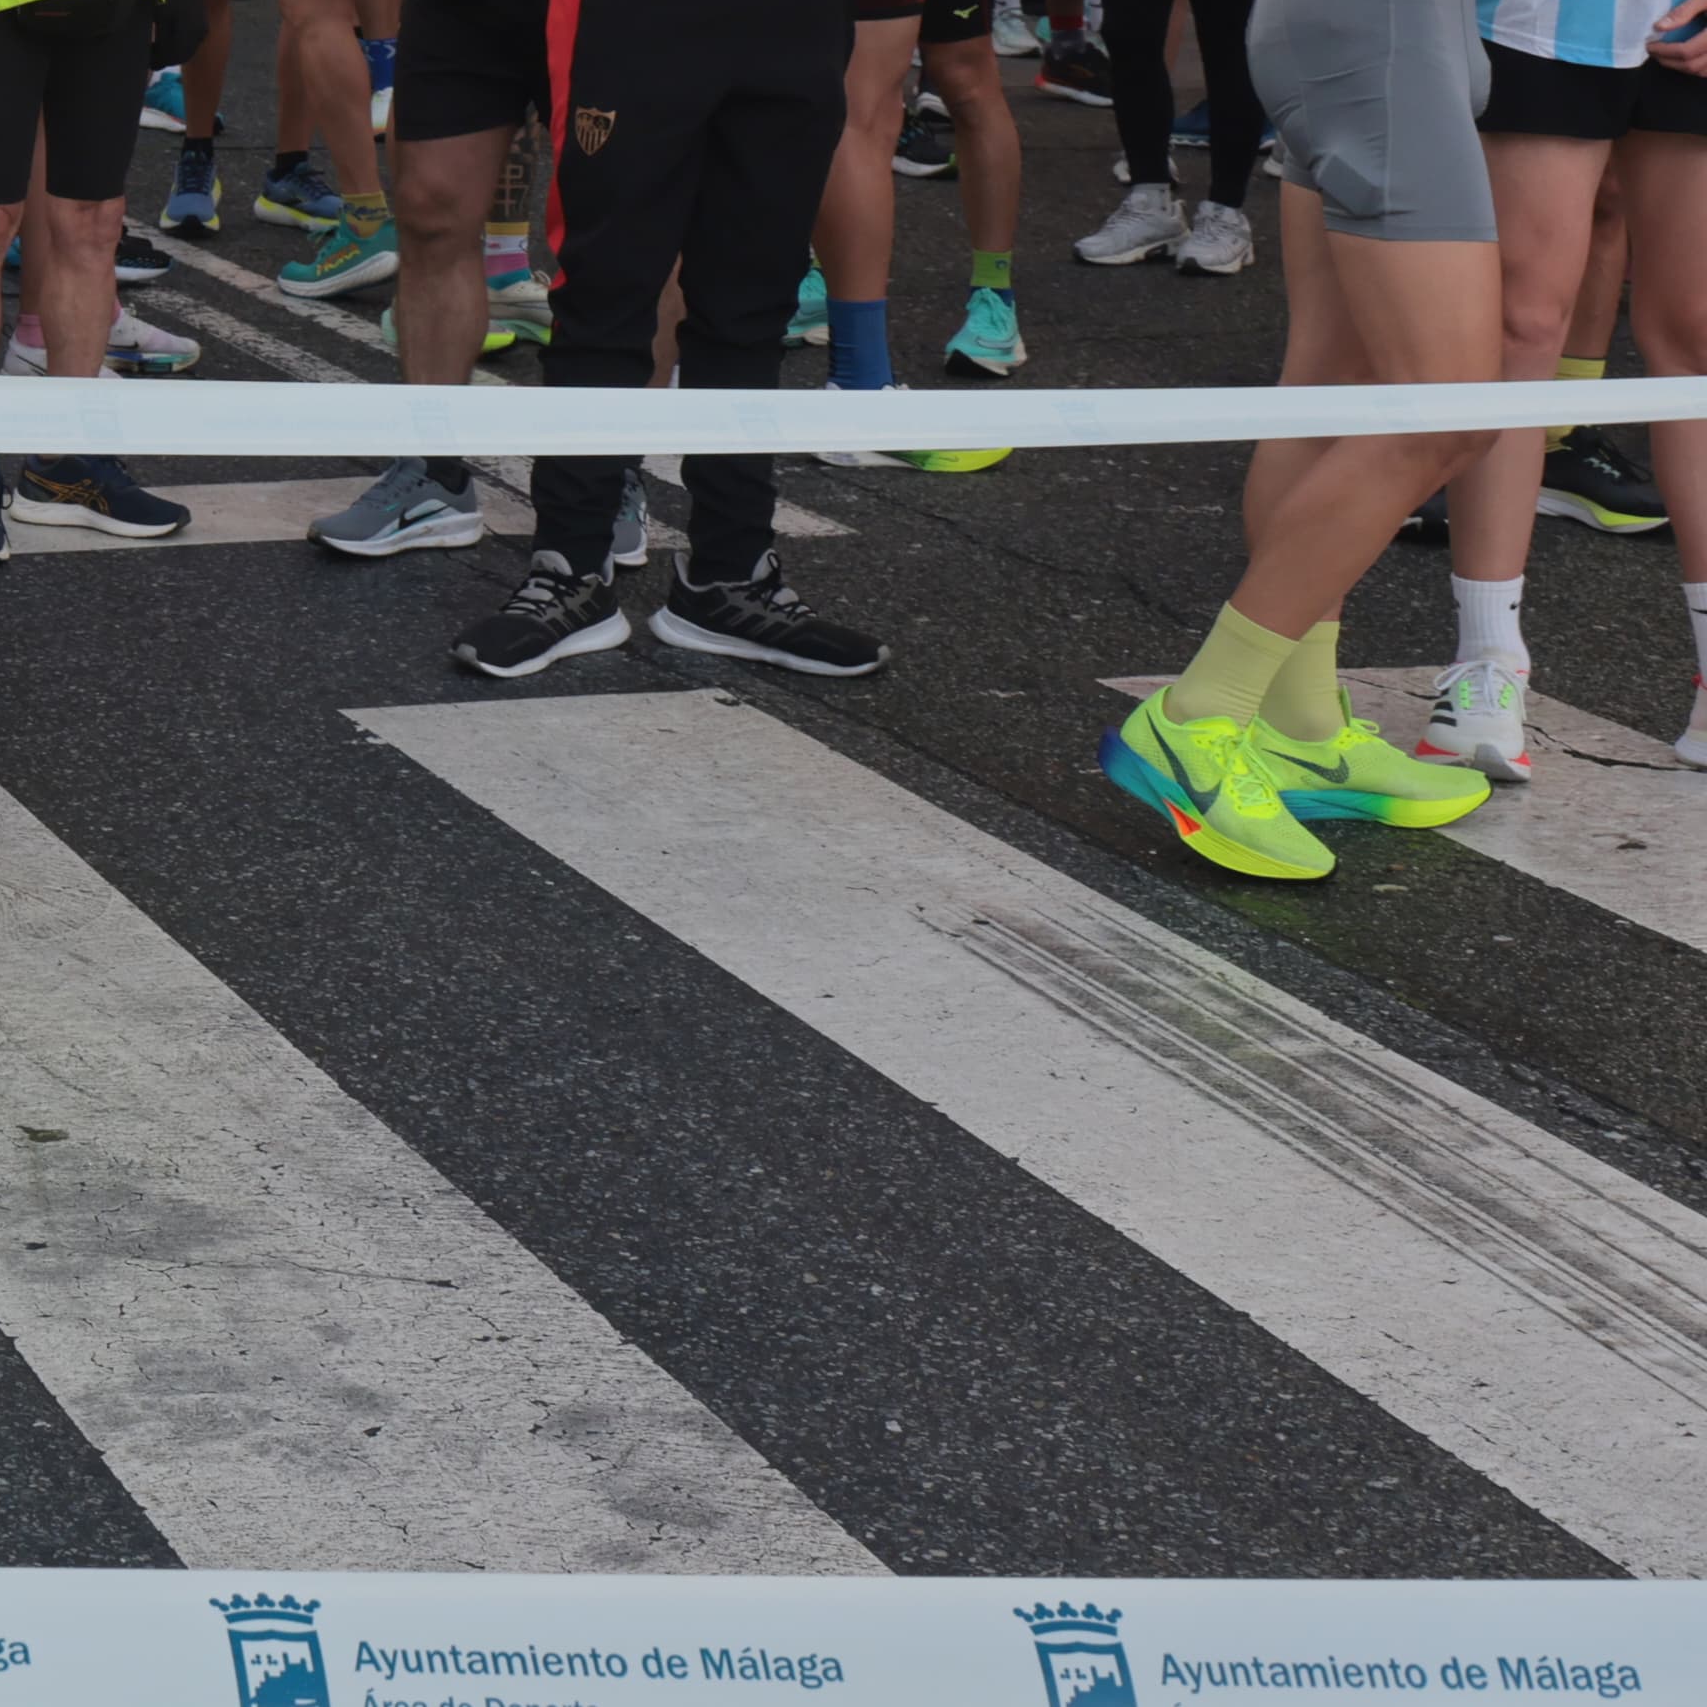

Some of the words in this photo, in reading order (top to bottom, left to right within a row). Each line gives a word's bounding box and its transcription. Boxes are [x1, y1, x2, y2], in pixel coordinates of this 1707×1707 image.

[354, 1639, 630, 1680] Ayuntamiento
[641, 1648, 689, 1678] de
[701, 1645, 844, 1689] Málaga
[1159, 1652, 1437, 1694] Ayuntamiento
[1452, 1660, 1497, 1688] de
[1505, 1657, 1641, 1699] Málaga
